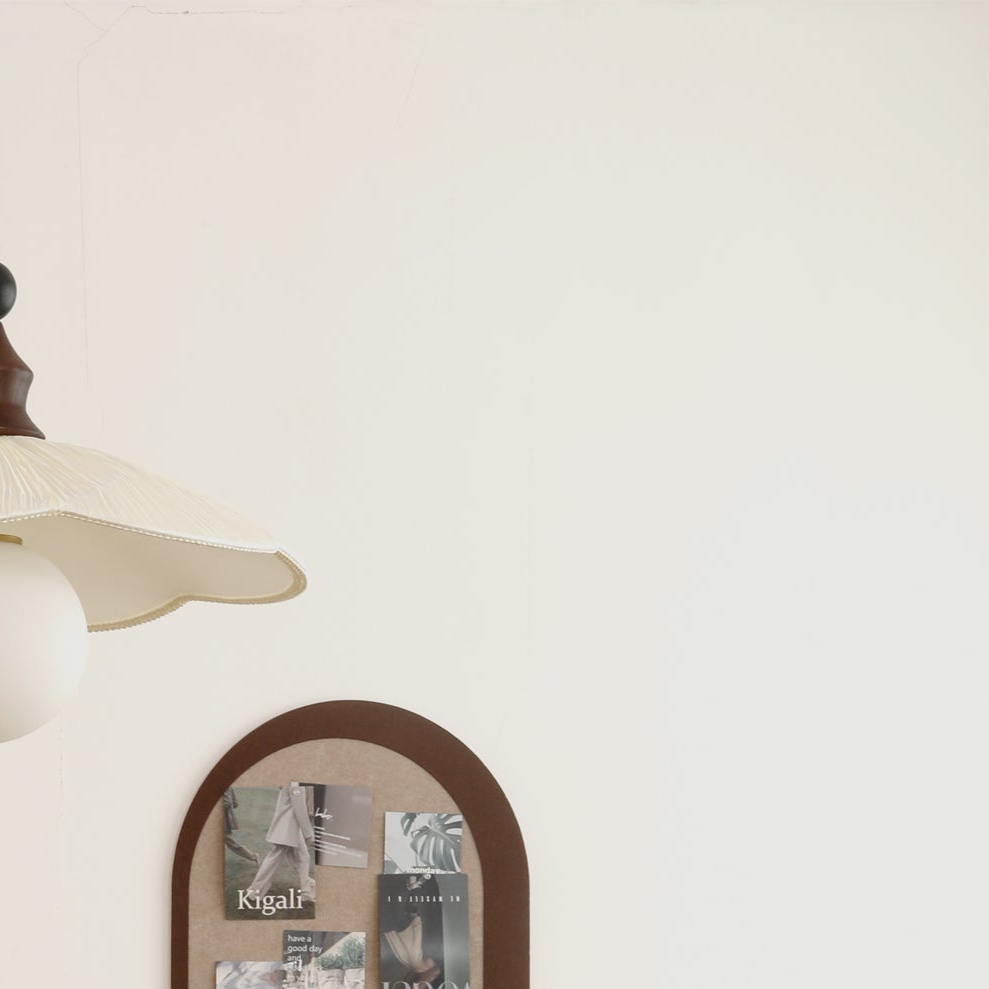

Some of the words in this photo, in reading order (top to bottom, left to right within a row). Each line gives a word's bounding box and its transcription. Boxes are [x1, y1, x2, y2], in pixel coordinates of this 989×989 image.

[238, 889, 304, 915] Kigali
[288, 934, 305, 942] have
[287, 944, 308, 953] good
[309, 944, 322, 954] day
